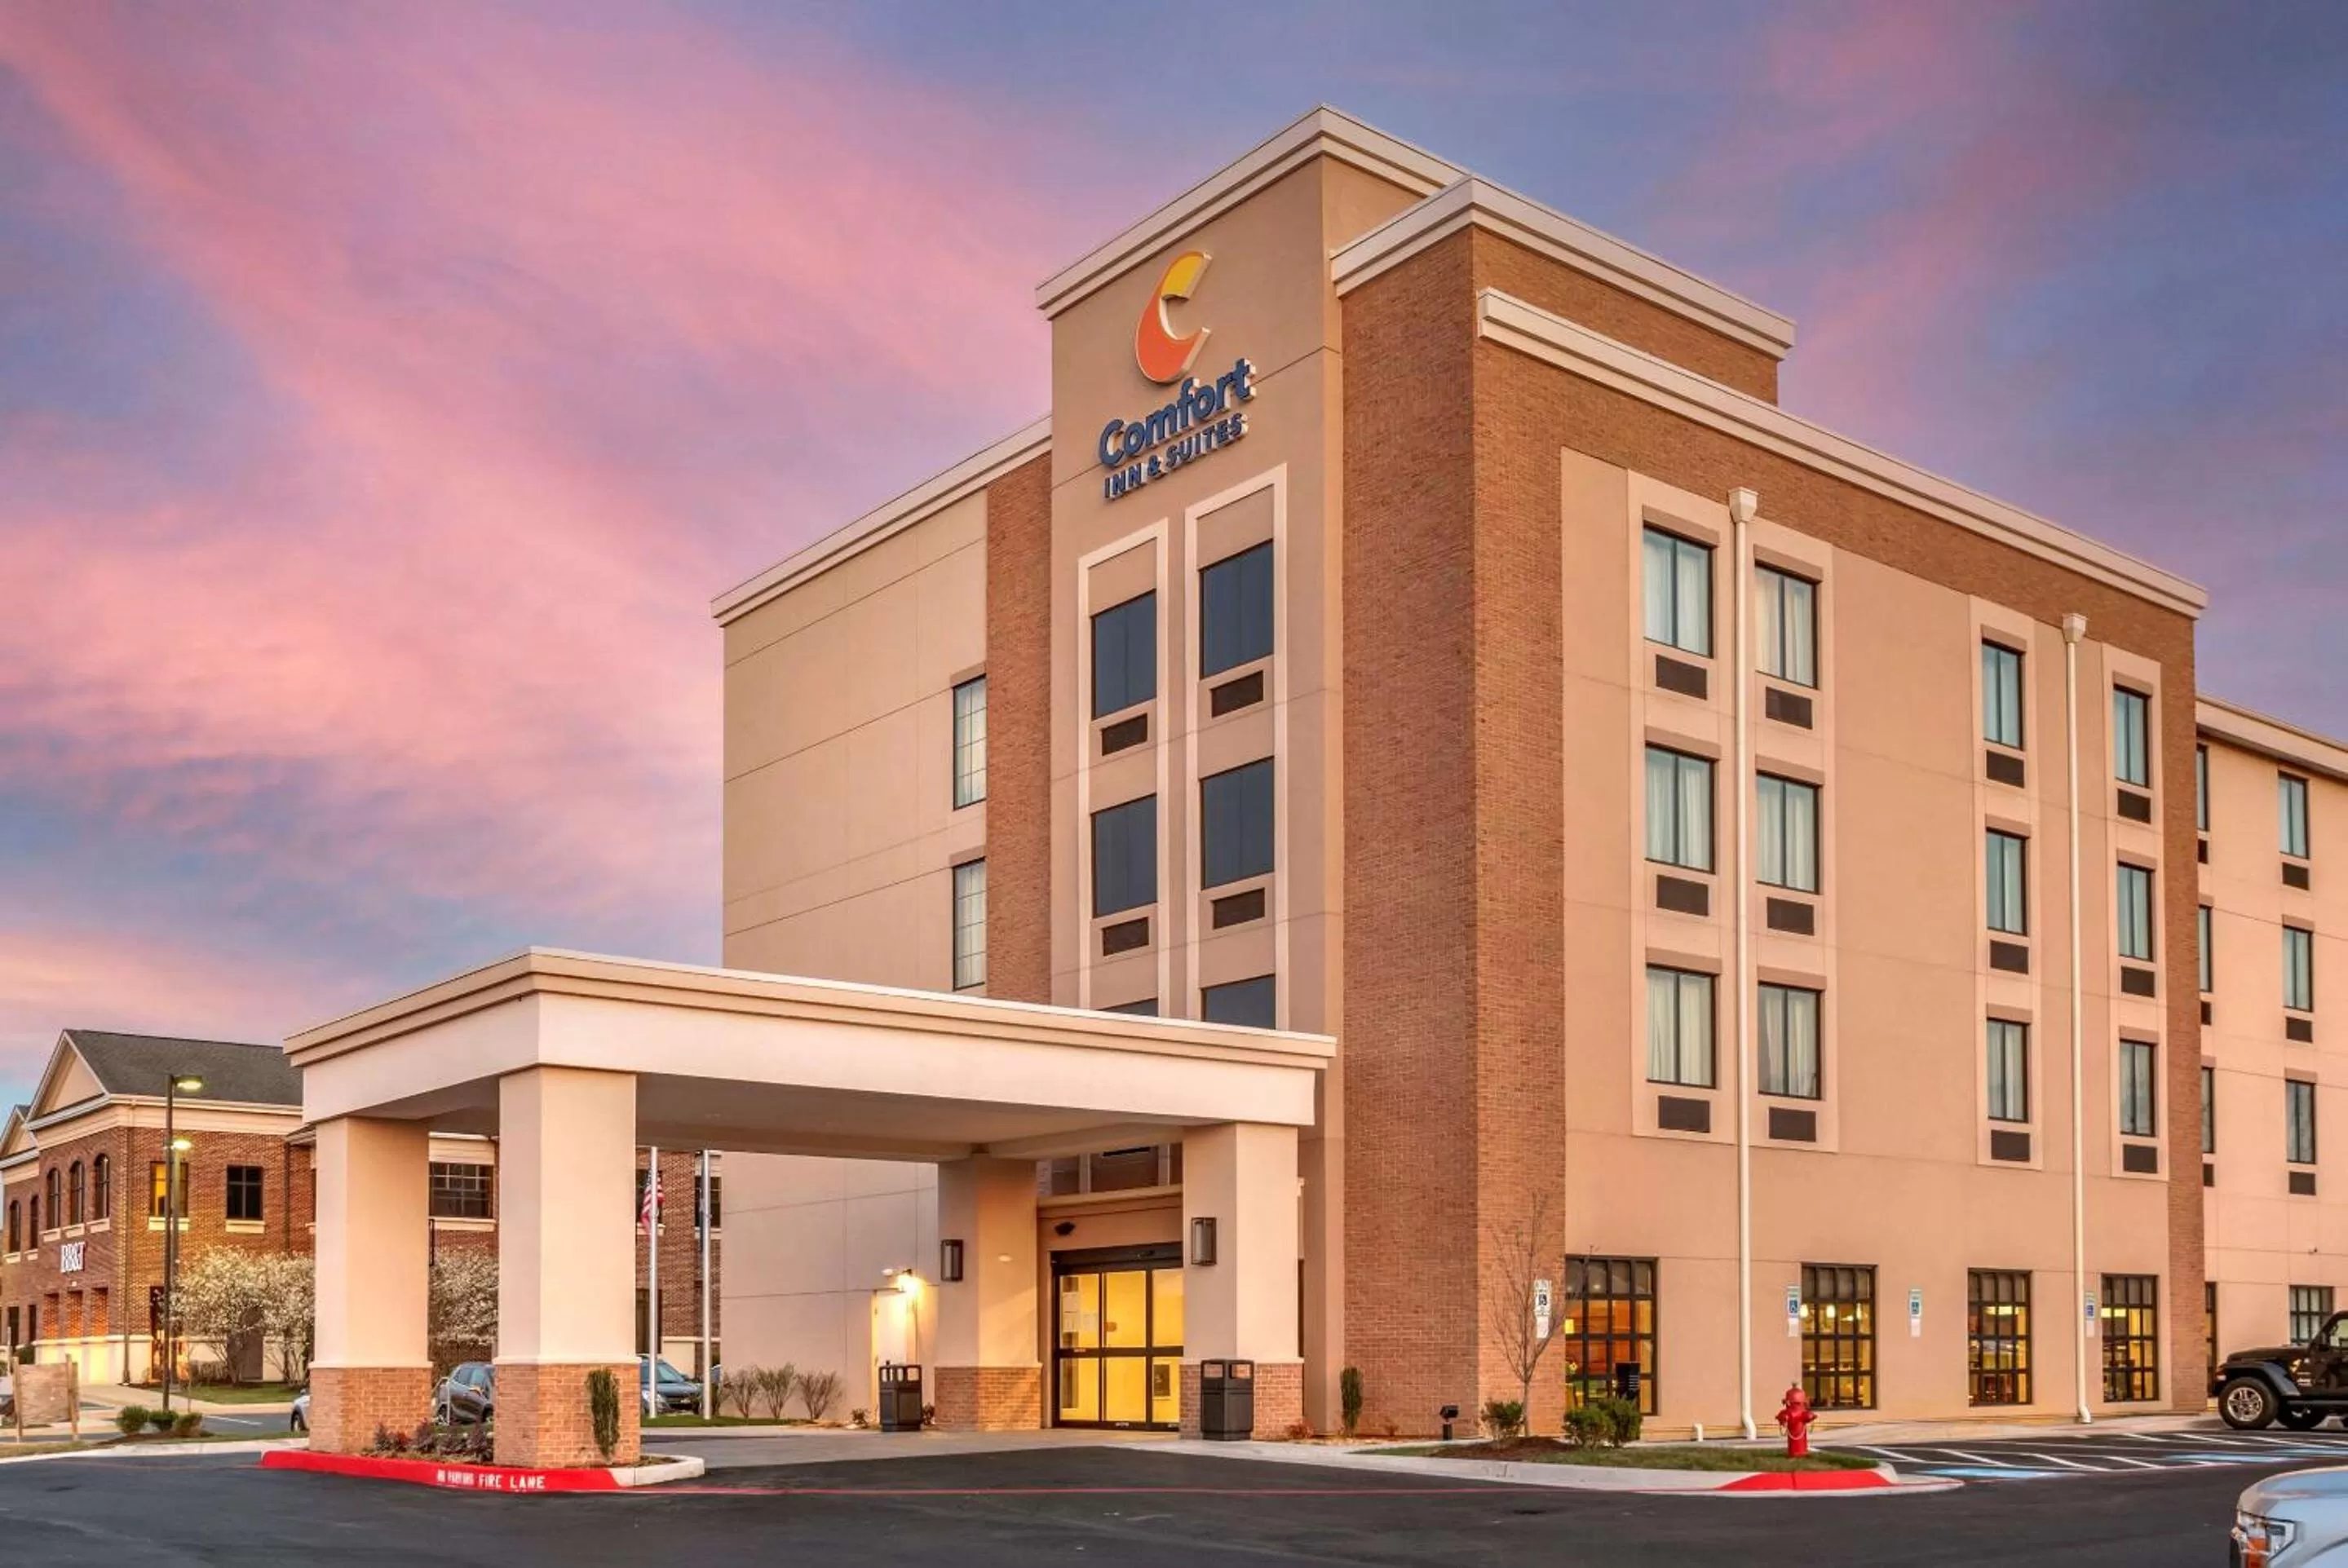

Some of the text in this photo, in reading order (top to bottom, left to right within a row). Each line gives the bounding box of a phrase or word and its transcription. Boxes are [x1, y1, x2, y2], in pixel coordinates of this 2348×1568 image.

[1099, 357, 1257, 467] Comfort
[1103, 413, 1249, 501] INN & SUITES
[479, 1474, 502, 1488] FIRE
[510, 1475, 545, 1489] LANE
